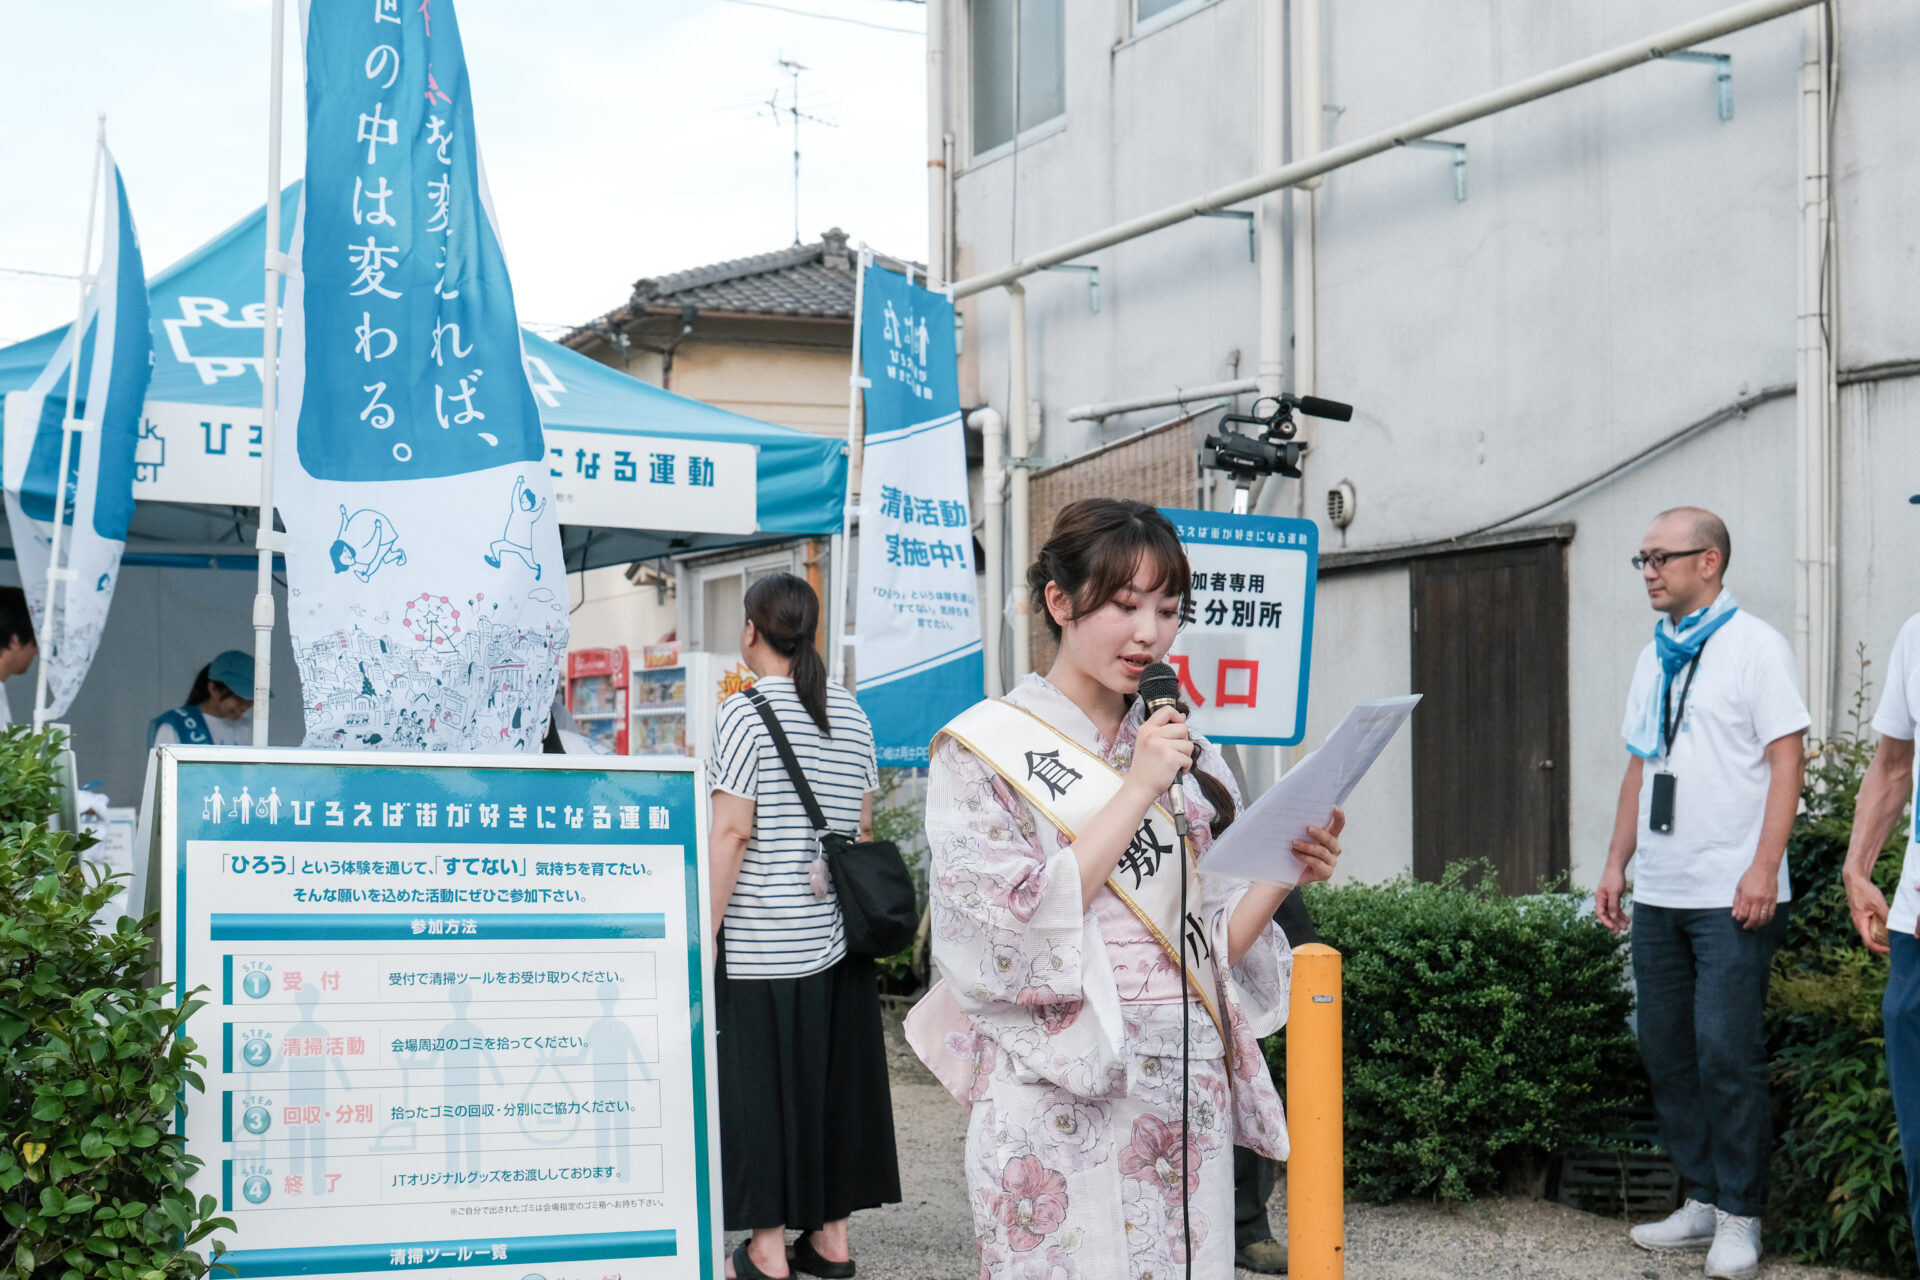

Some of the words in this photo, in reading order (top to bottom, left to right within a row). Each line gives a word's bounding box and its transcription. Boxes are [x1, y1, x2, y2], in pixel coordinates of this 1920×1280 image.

[291, 800, 670, 830] ひろえば街が好きになる運動
[293, 887, 586, 904] そんな願いを込めた活動にぜひご参加下さい。
[410, 918, 478, 935] 参加方法
[242, 961, 273, 972] STEP
[388, 970, 625, 987] 受付で清掃ツールをお受け取りください。
[241, 1029, 273, 1041] STEP
[282, 1036, 366, 1057] 清掃活動
[391, 1035, 589, 1053] 会場周辺のゴミを拾ってください。
[242, 1095, 273, 1107] STEP
[283, 1104, 374, 1125] 回収・分別
[391, 1100, 636, 1121] 拾ったゴミの回収・分別にご協力ください。
[241, 1165, 273, 1178] STEP
[391, 1166, 622, 1188] JTオリジナルグッズをお渡ししております。
[389, 1242, 508, 1266] 清掃ツール一覧
